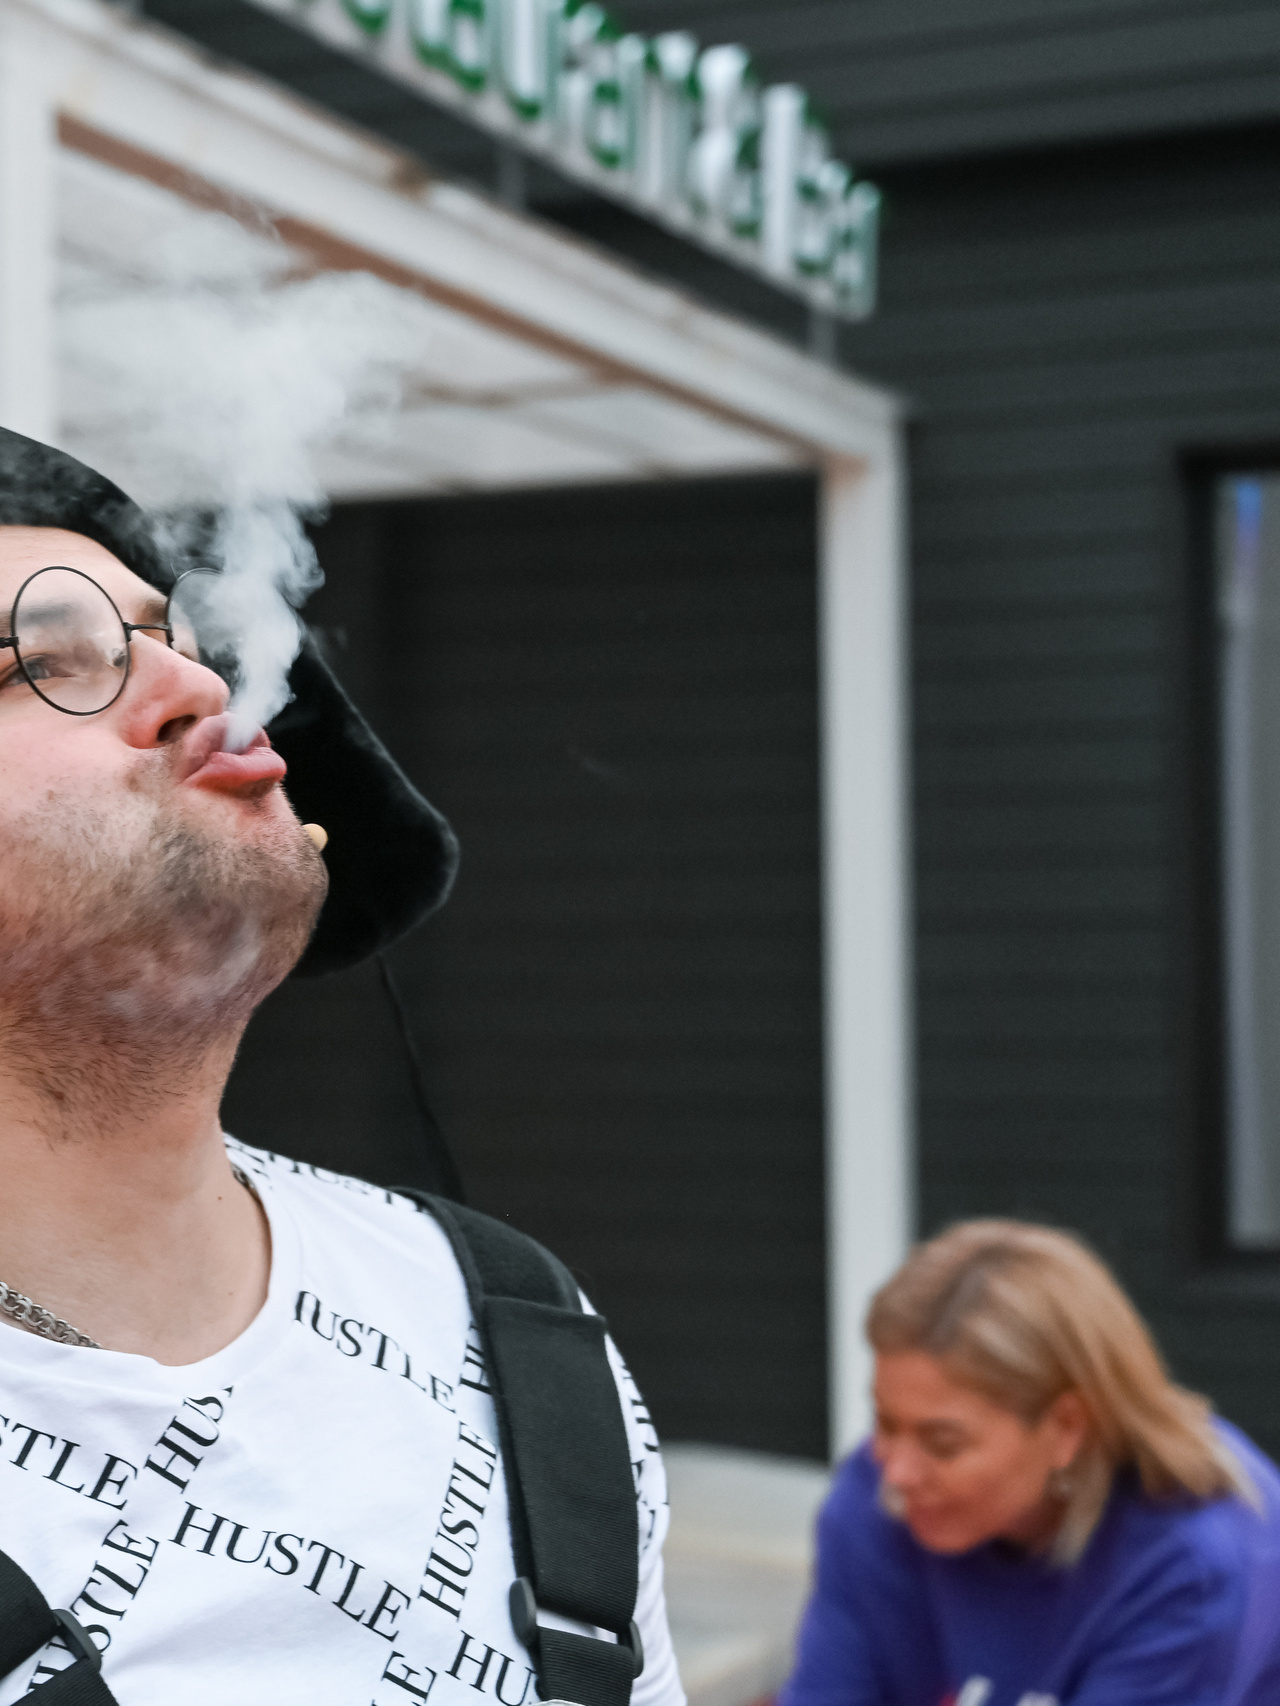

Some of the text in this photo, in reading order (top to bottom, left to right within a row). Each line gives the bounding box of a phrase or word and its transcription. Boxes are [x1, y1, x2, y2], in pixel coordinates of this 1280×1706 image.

[143, 1385, 234, 1494] HUS
[167, 1501, 411, 1642] HUSTLE
[417, 1421, 498, 1622] HUSTLE
[445, 1630, 537, 1706] HU
